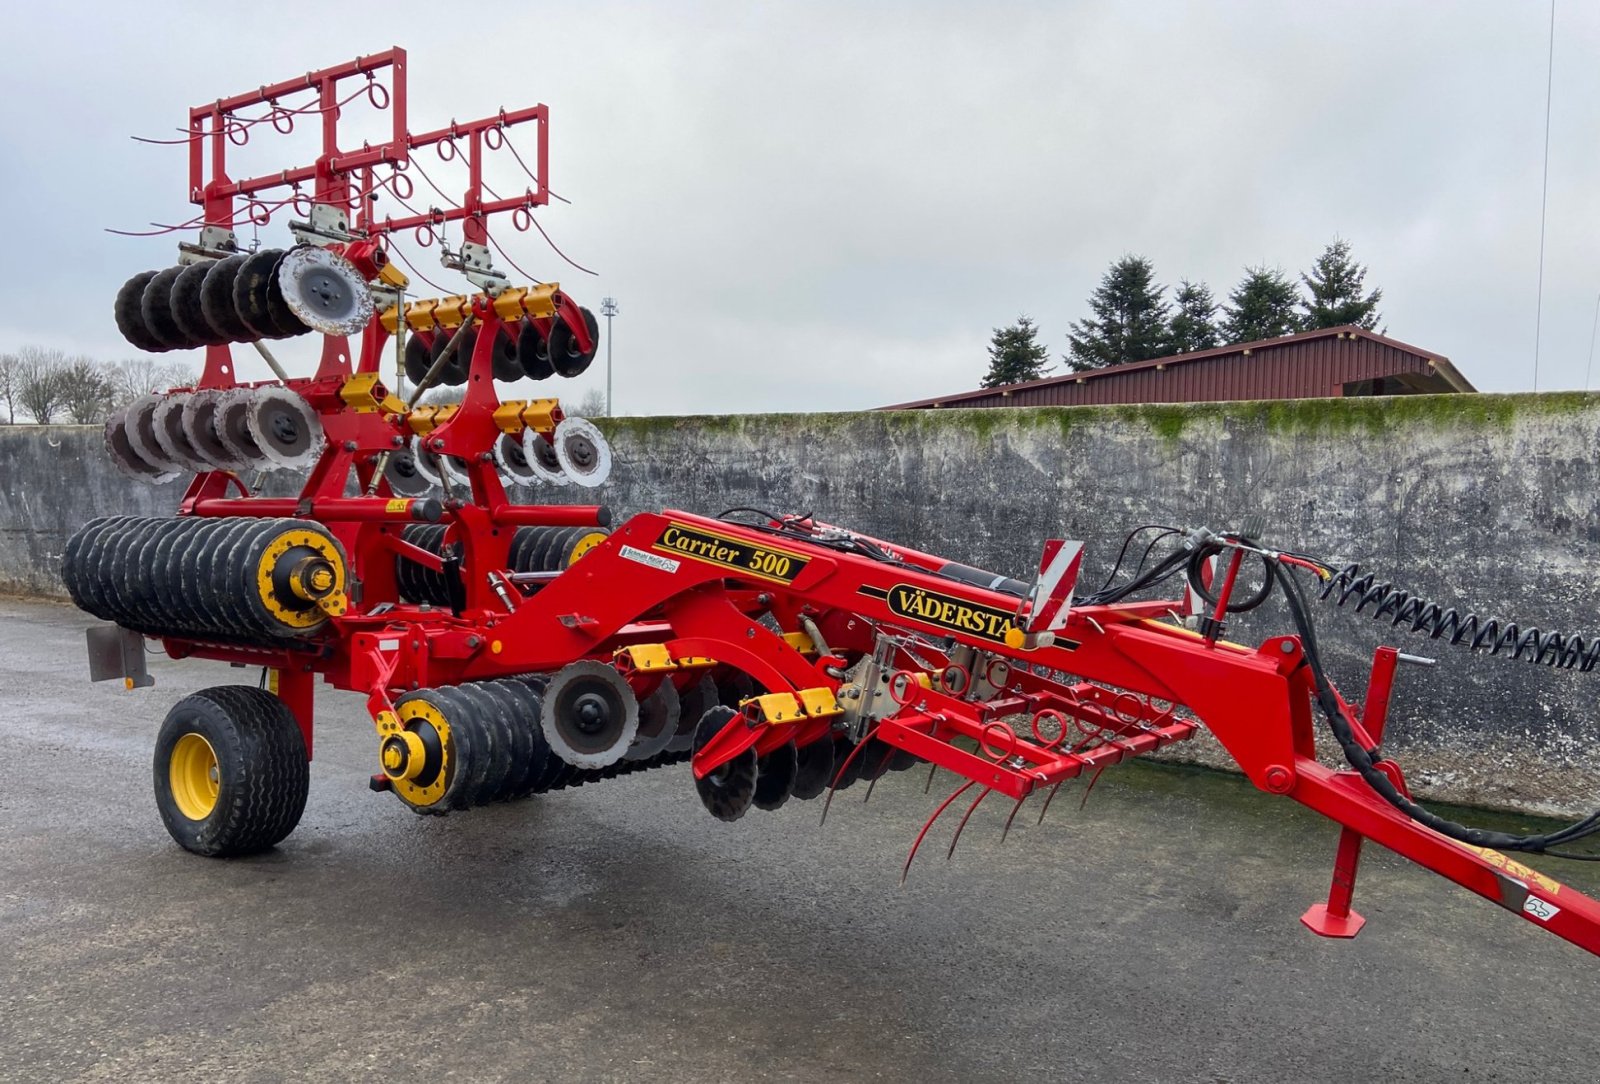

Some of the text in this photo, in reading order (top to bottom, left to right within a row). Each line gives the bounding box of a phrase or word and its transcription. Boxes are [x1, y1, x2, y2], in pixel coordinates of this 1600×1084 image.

[663, 528, 791, 577] Carrier 500
[898, 589, 1013, 638] VÄDERSTA
